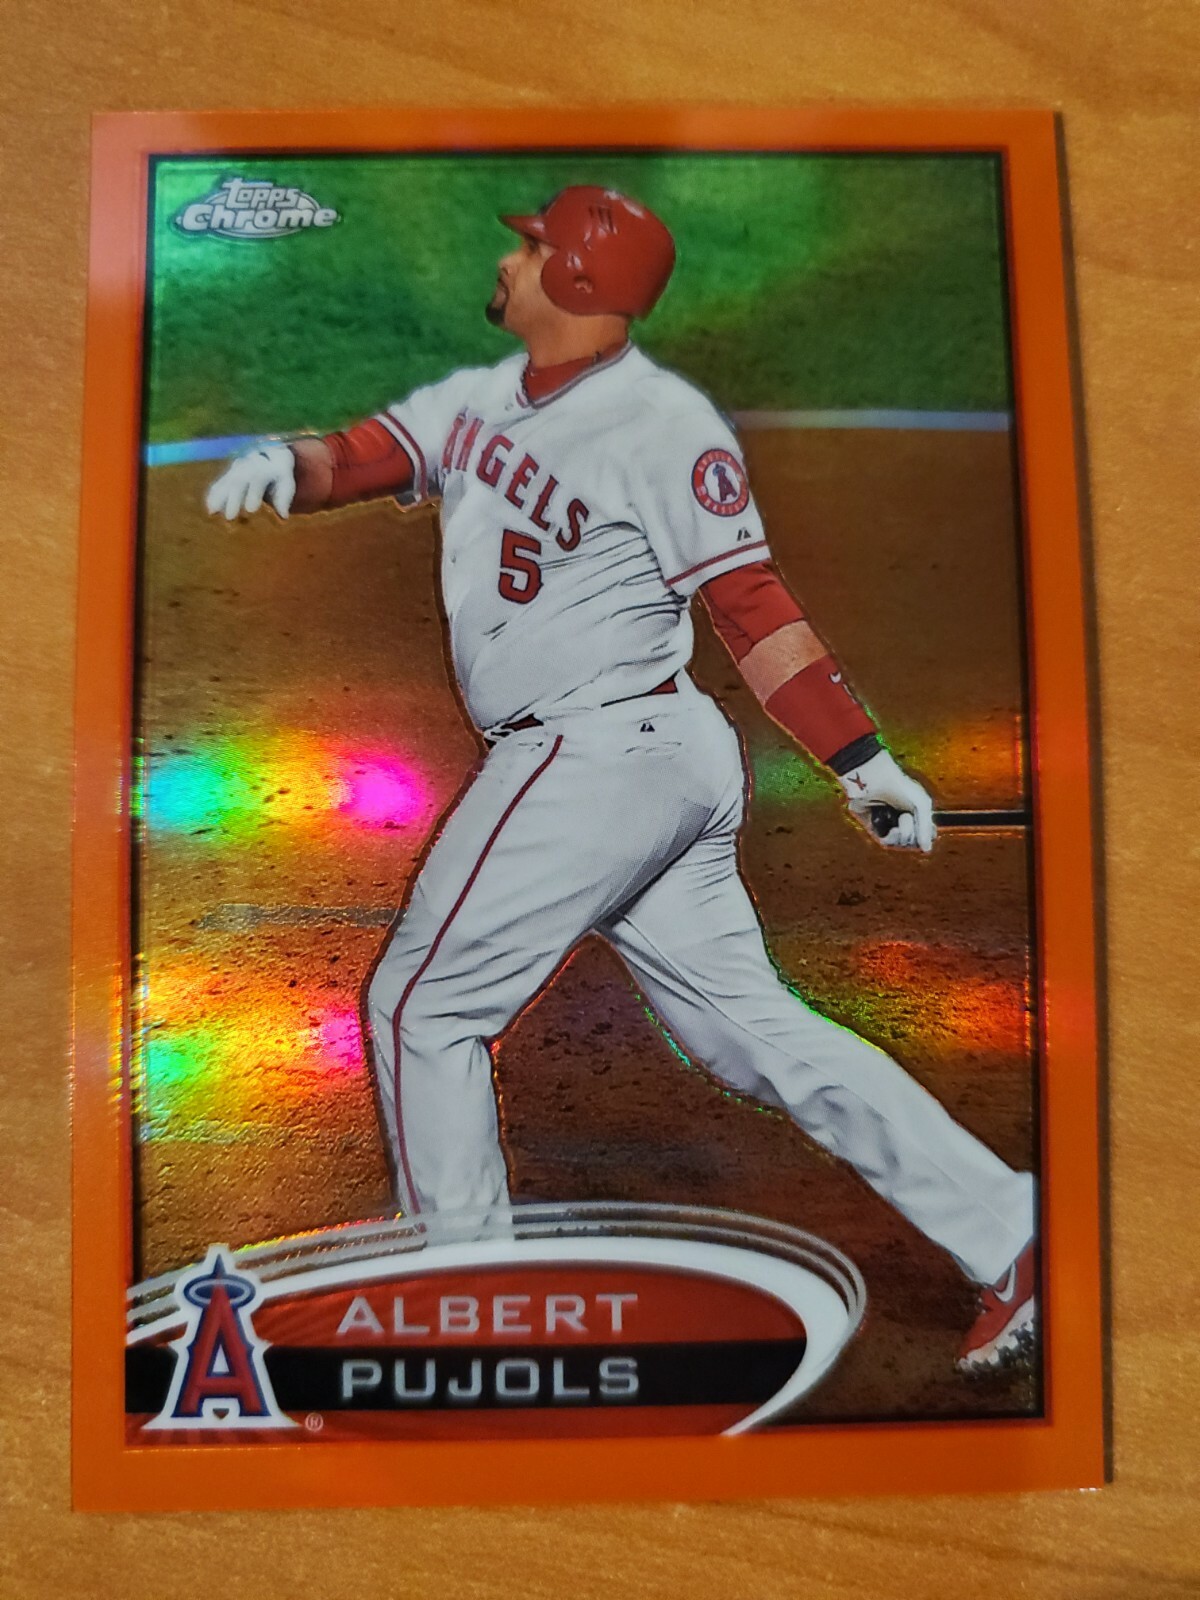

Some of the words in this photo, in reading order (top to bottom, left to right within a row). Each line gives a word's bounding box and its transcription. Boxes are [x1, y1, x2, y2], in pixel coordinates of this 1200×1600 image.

[182, 203, 338, 231] Chrome
[498, 528, 544, 605] 5
[336, 1293, 639, 1335] ALBERT
[341, 1356, 640, 1399] PUJOLS
